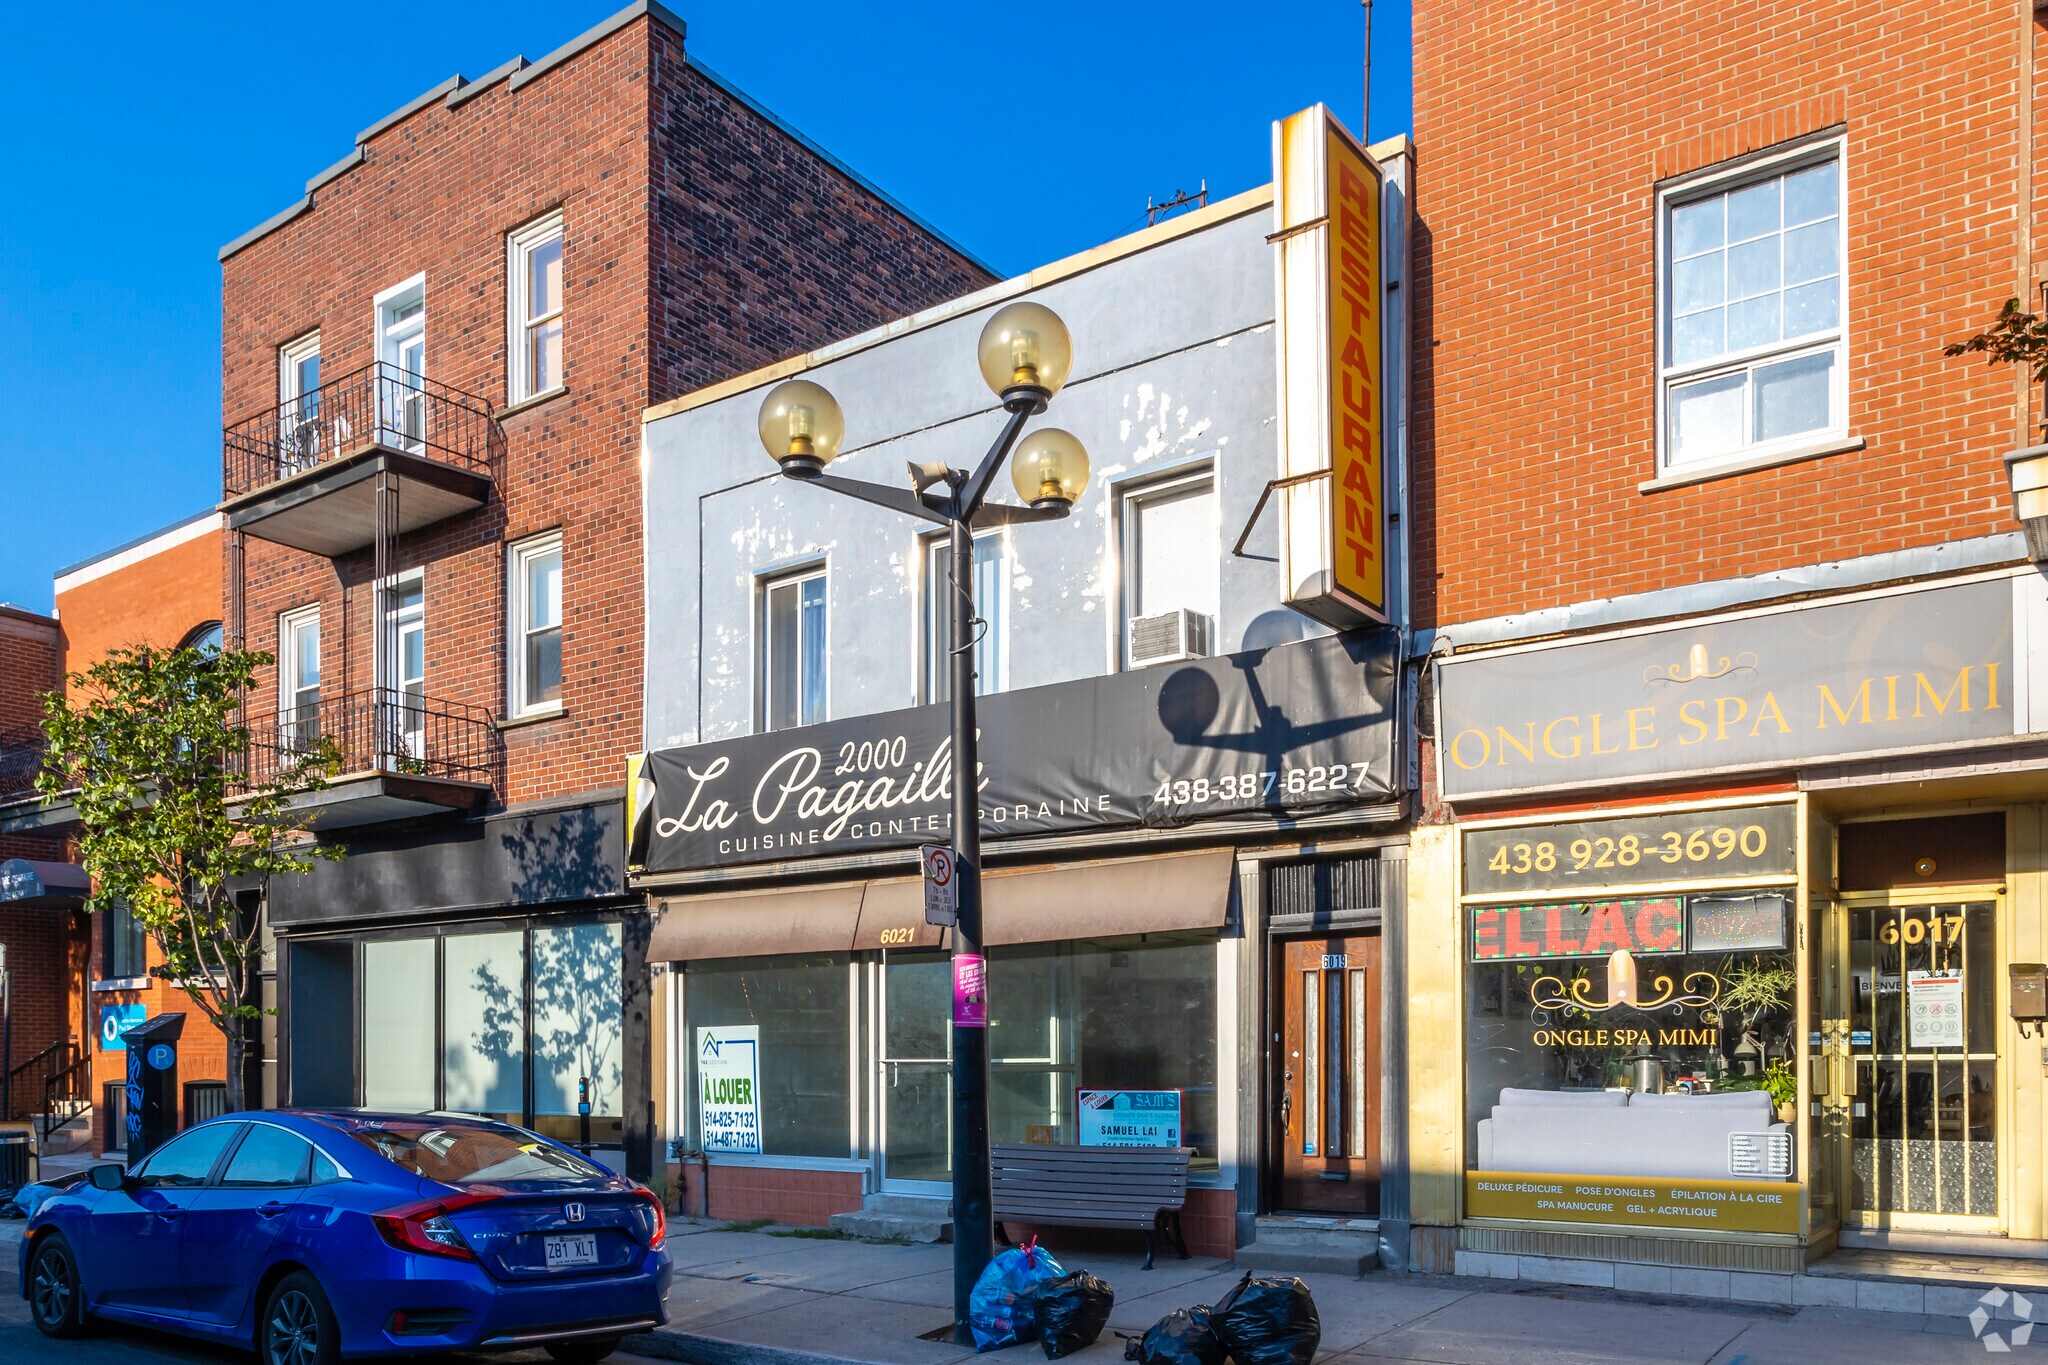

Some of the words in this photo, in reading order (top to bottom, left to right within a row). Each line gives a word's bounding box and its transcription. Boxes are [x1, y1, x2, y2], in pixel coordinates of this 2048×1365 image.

[1339, 159, 1374, 581] RESTAURANT
[1450, 706, 1660, 771] ONGLE
[1678, 690, 1791, 746] SPA
[1816, 661, 2004, 729] MIMI
[834, 735, 908, 777] 2000
[1153, 761, 1371, 807] 438-387-6227
[656, 756, 739, 838] La
[719, 829, 822, 854] CUISINE
[851, 793, 1111, 840] CONTEORAINE
[1488, 842, 1557, 875] 438
[1569, 825, 1767, 871] 928-3690
[880, 927, 915, 945] 6021
[1475, 902, 1681, 957] ELLAC
[1879, 916, 1965, 945] 6017
[1323, 955, 1347, 968] 6019
[1533, 1028, 1609, 1048] ONGLE
[1613, 1028, 1653, 1047] SPA
[1658, 1028, 1717, 1047] MIMI
[704, 1072, 712, 1104] À
[713, 1077, 753, 1105] LOUER
[1082, 1092, 1098, 1106] ESPACE
[1135, 1093, 1176, 1107] SAM'S
[705, 1110, 755, 1129] 514-825-7132
[706, 1130, 756, 1149] 514-487-7132
[1101, 1125, 1139, 1136] SAMUEL
[1142, 1126, 1158, 1136] LAI
[1477, 1182, 1514, 1192] DELUXE
[1515, 1182, 1563, 1194] PÉDICURE
[1575, 1186, 1602, 1196] POSE
[1604, 1187, 1656, 1198] D'ONGLES
[1671, 1188, 1727, 1201] ÉPILATION
[1729, 1190, 1737, 1201] À
[1739, 1193, 1754, 1202] LA
[1756, 1194, 1783, 1204] CIRE
[1537, 1200, 1555, 1209] SPA
[1557, 1201, 1614, 1212] MANUCURE
[1626, 1204, 1647, 1214] GEL
[1657, 1206, 1718, 1217] ACRYLIQUE
[547, 1242, 568, 1259] Z81
[575, 1240, 595, 1257] XLT
